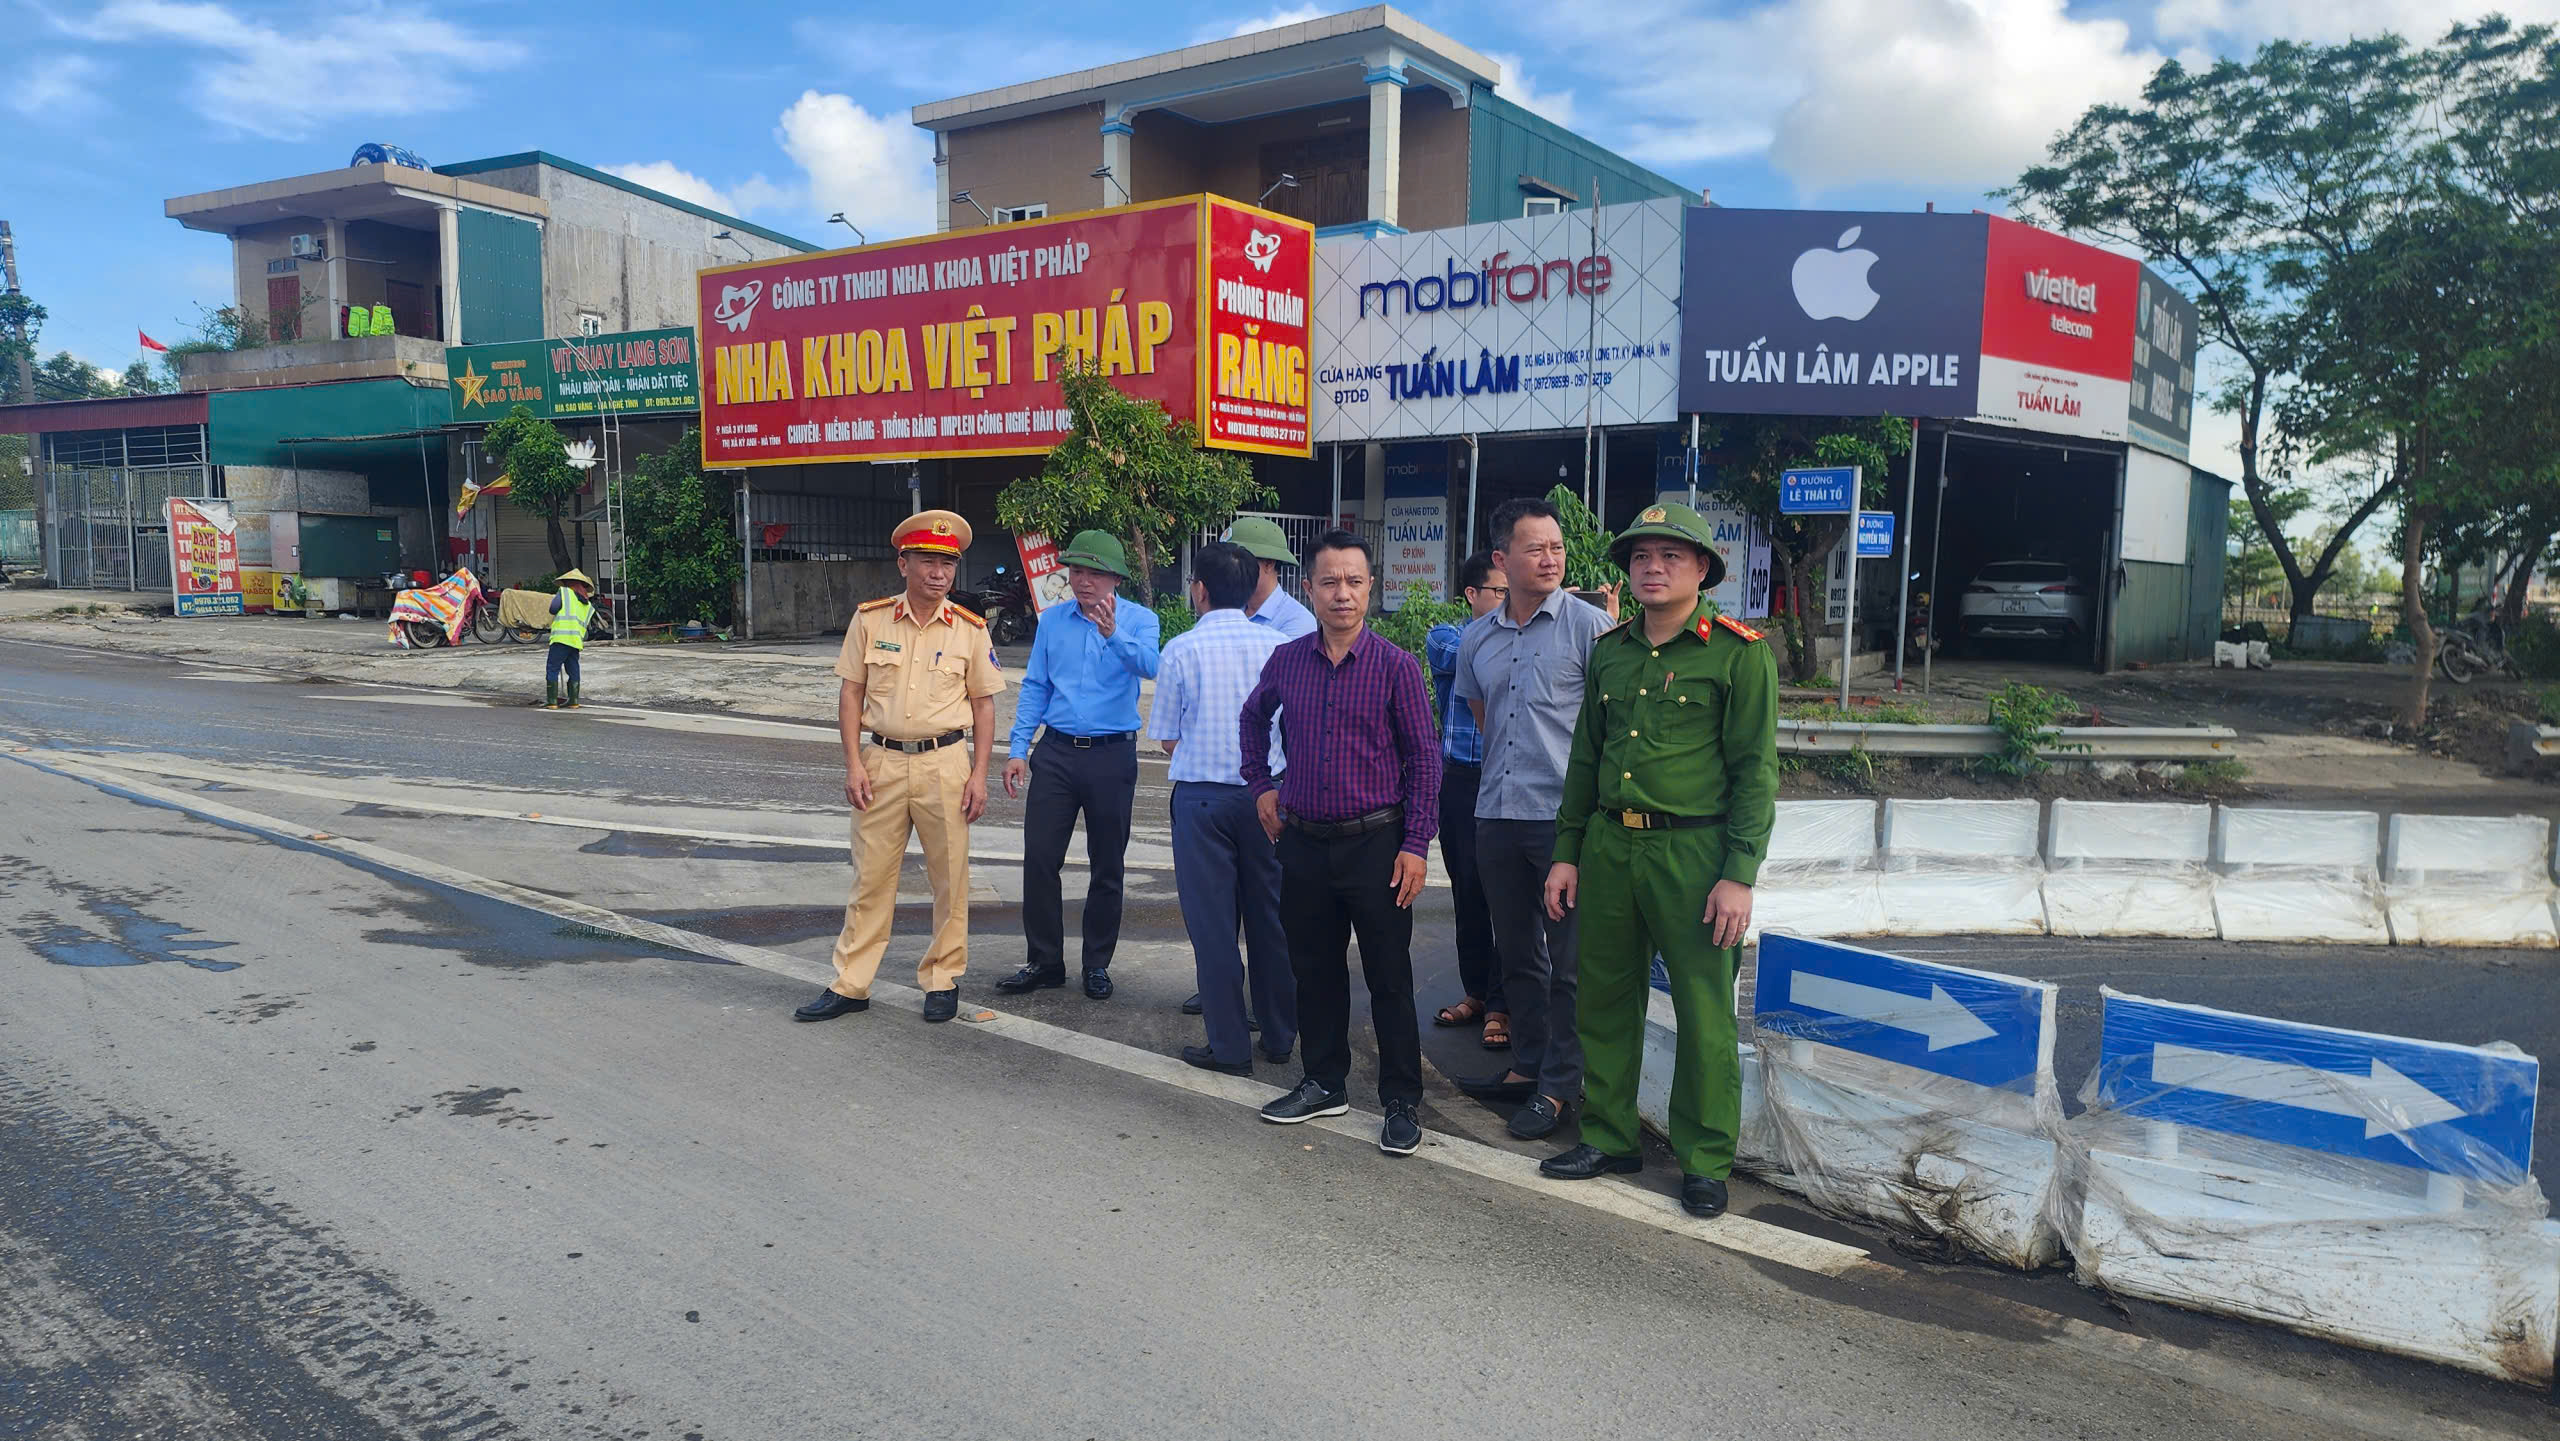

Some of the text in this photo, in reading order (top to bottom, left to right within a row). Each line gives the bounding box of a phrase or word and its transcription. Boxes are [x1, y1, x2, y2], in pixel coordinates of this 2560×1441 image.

[772, 238, 1090, 310] CÔNG TY TNHH NHA KHOA VIỆT PHÁP
[1360, 250, 1613, 319] mobifone
[1218, 275, 1304, 328] PHÒNG KHÁM
[2025, 269, 2097, 313] viettel
[2050, 314, 2093, 339] telecom
[551, 348, 573, 380] VỊT
[618, 339, 656, 376] LẠNG
[658, 336, 691, 366] SƠN
[715, 287, 1173, 405] NHA KHOA VIỆT PHÁP
[1217, 322, 1305, 407] RĂNG
[1320, 361, 1383, 384] CỬA HÀNG
[1385, 345, 1519, 401] TUẤN LÂM
[1705, 336, 1960, 387] TUẤN LÂM APPLE
[626, 373, 650, 397] NHẬN
[651, 371, 671, 395] ĐẶT
[671, 370, 689, 391] TIỆC
[1575, 371, 1612, 387] 091732789
[1334, 388, 1370, 405] ĐTDĐ
[2017, 384, 2081, 417] TUẤN LÂM
[733, 425, 736, 434] 3
[744, 423, 758, 433] LONG
[787, 420, 822, 444] CHUYÊN:
[825, 416, 851, 442] NIỀNG
[852, 417, 876, 441] RĂNG
[882, 411, 911, 439] TRỒNG
[912, 413, 937, 438] RĂNG
[940, 413, 975, 437] IMPLEN
[977, 410, 1003, 435] CÔNG
[1005, 407, 1031, 436] NGHỆ
[1033, 405, 1054, 432] HÀN
[1227, 421, 1259, 437] HOTLINE
[1260, 425, 1279, 439] 0983
[1279, 428, 1288, 440] 27
[761, 435, 769, 446] HÀ
[1801, 475, 1833, 485] ĐƯỜNG
[1789, 484, 1843, 502] LÊ THÁI TỔ
[1404, 505, 1422, 517] HÀNG
[1387, 518, 1443, 543] TUẤN LÂM
[1028, 553, 1057, 574] VIỆT
[1402, 546, 1425, 558] ÉP KÍNH
[1392, 564, 1407, 575] THAY
[1750, 560, 1768, 610] GÓP
